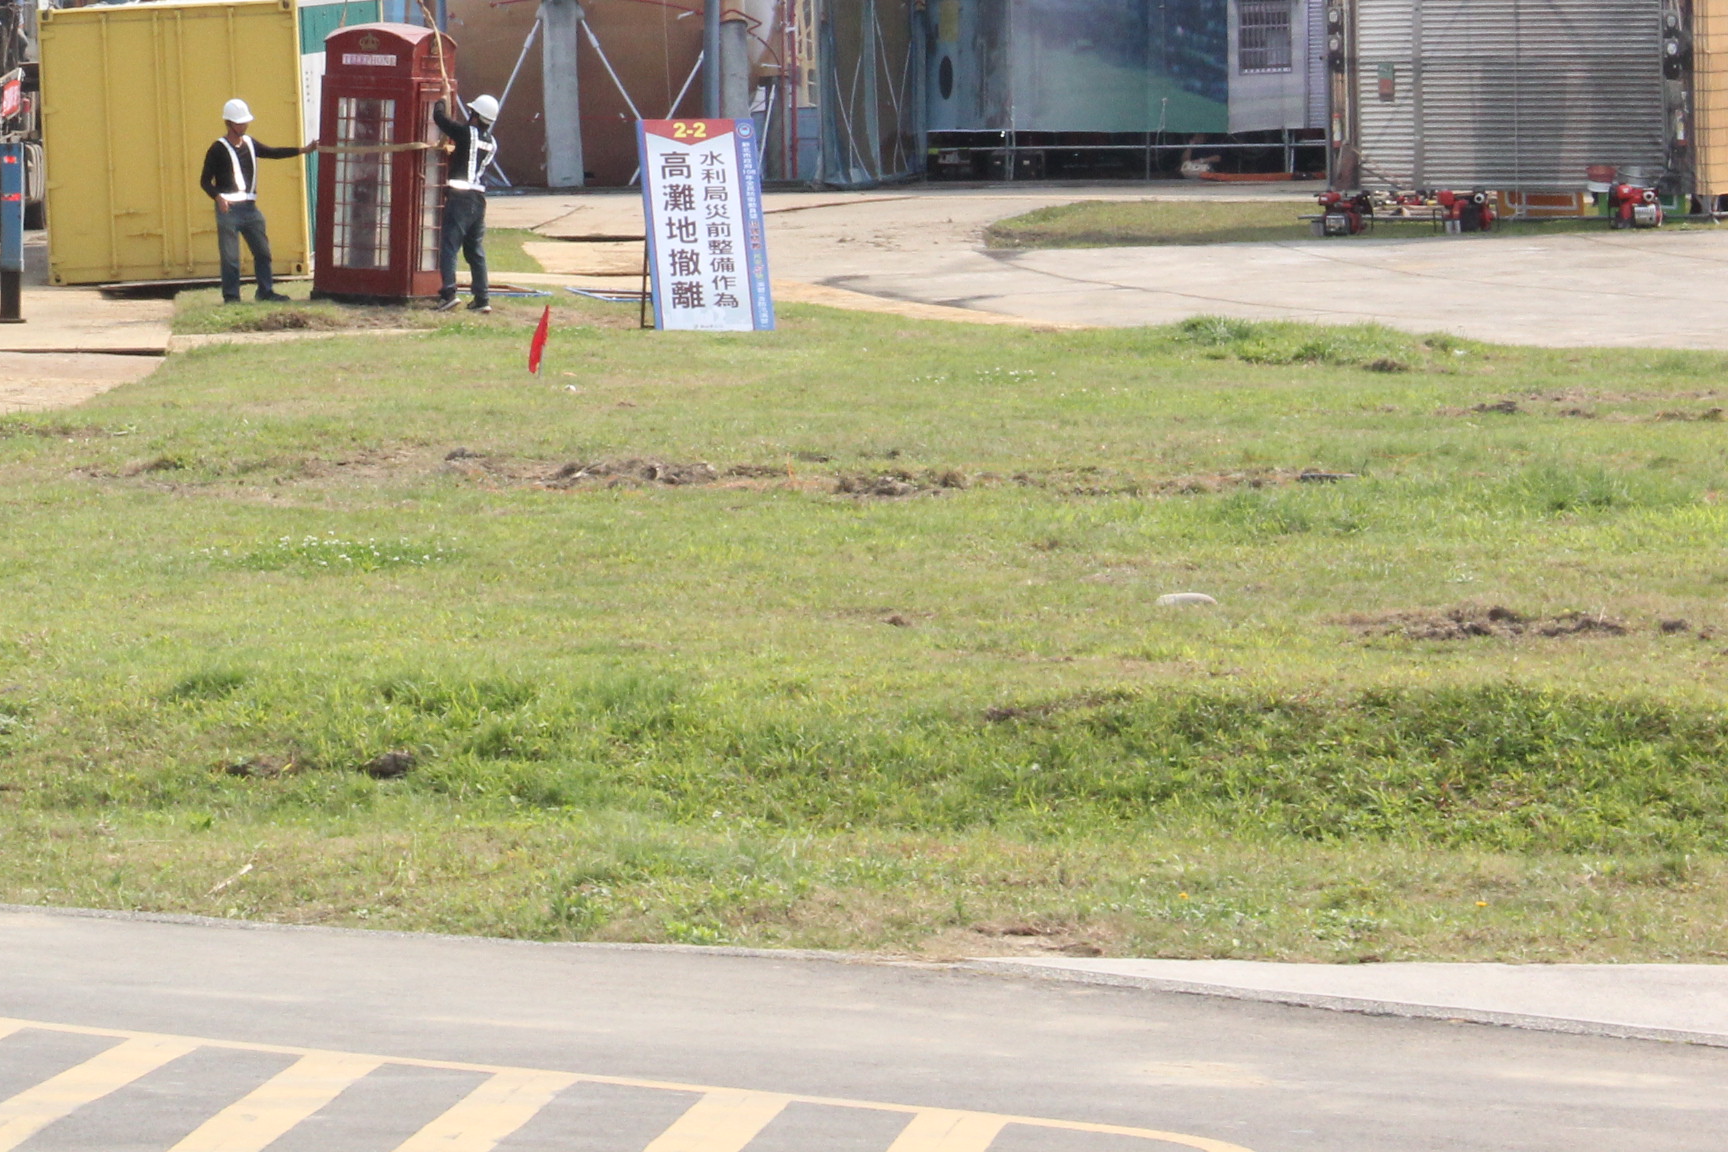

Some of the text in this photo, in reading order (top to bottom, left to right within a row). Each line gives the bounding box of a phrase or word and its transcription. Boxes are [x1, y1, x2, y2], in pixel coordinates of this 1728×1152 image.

[673, 122, 707, 138] 2-2
[660, 151, 706, 309] 高灘地撤離
[699, 150, 739, 309] 水利局災前整備作為
